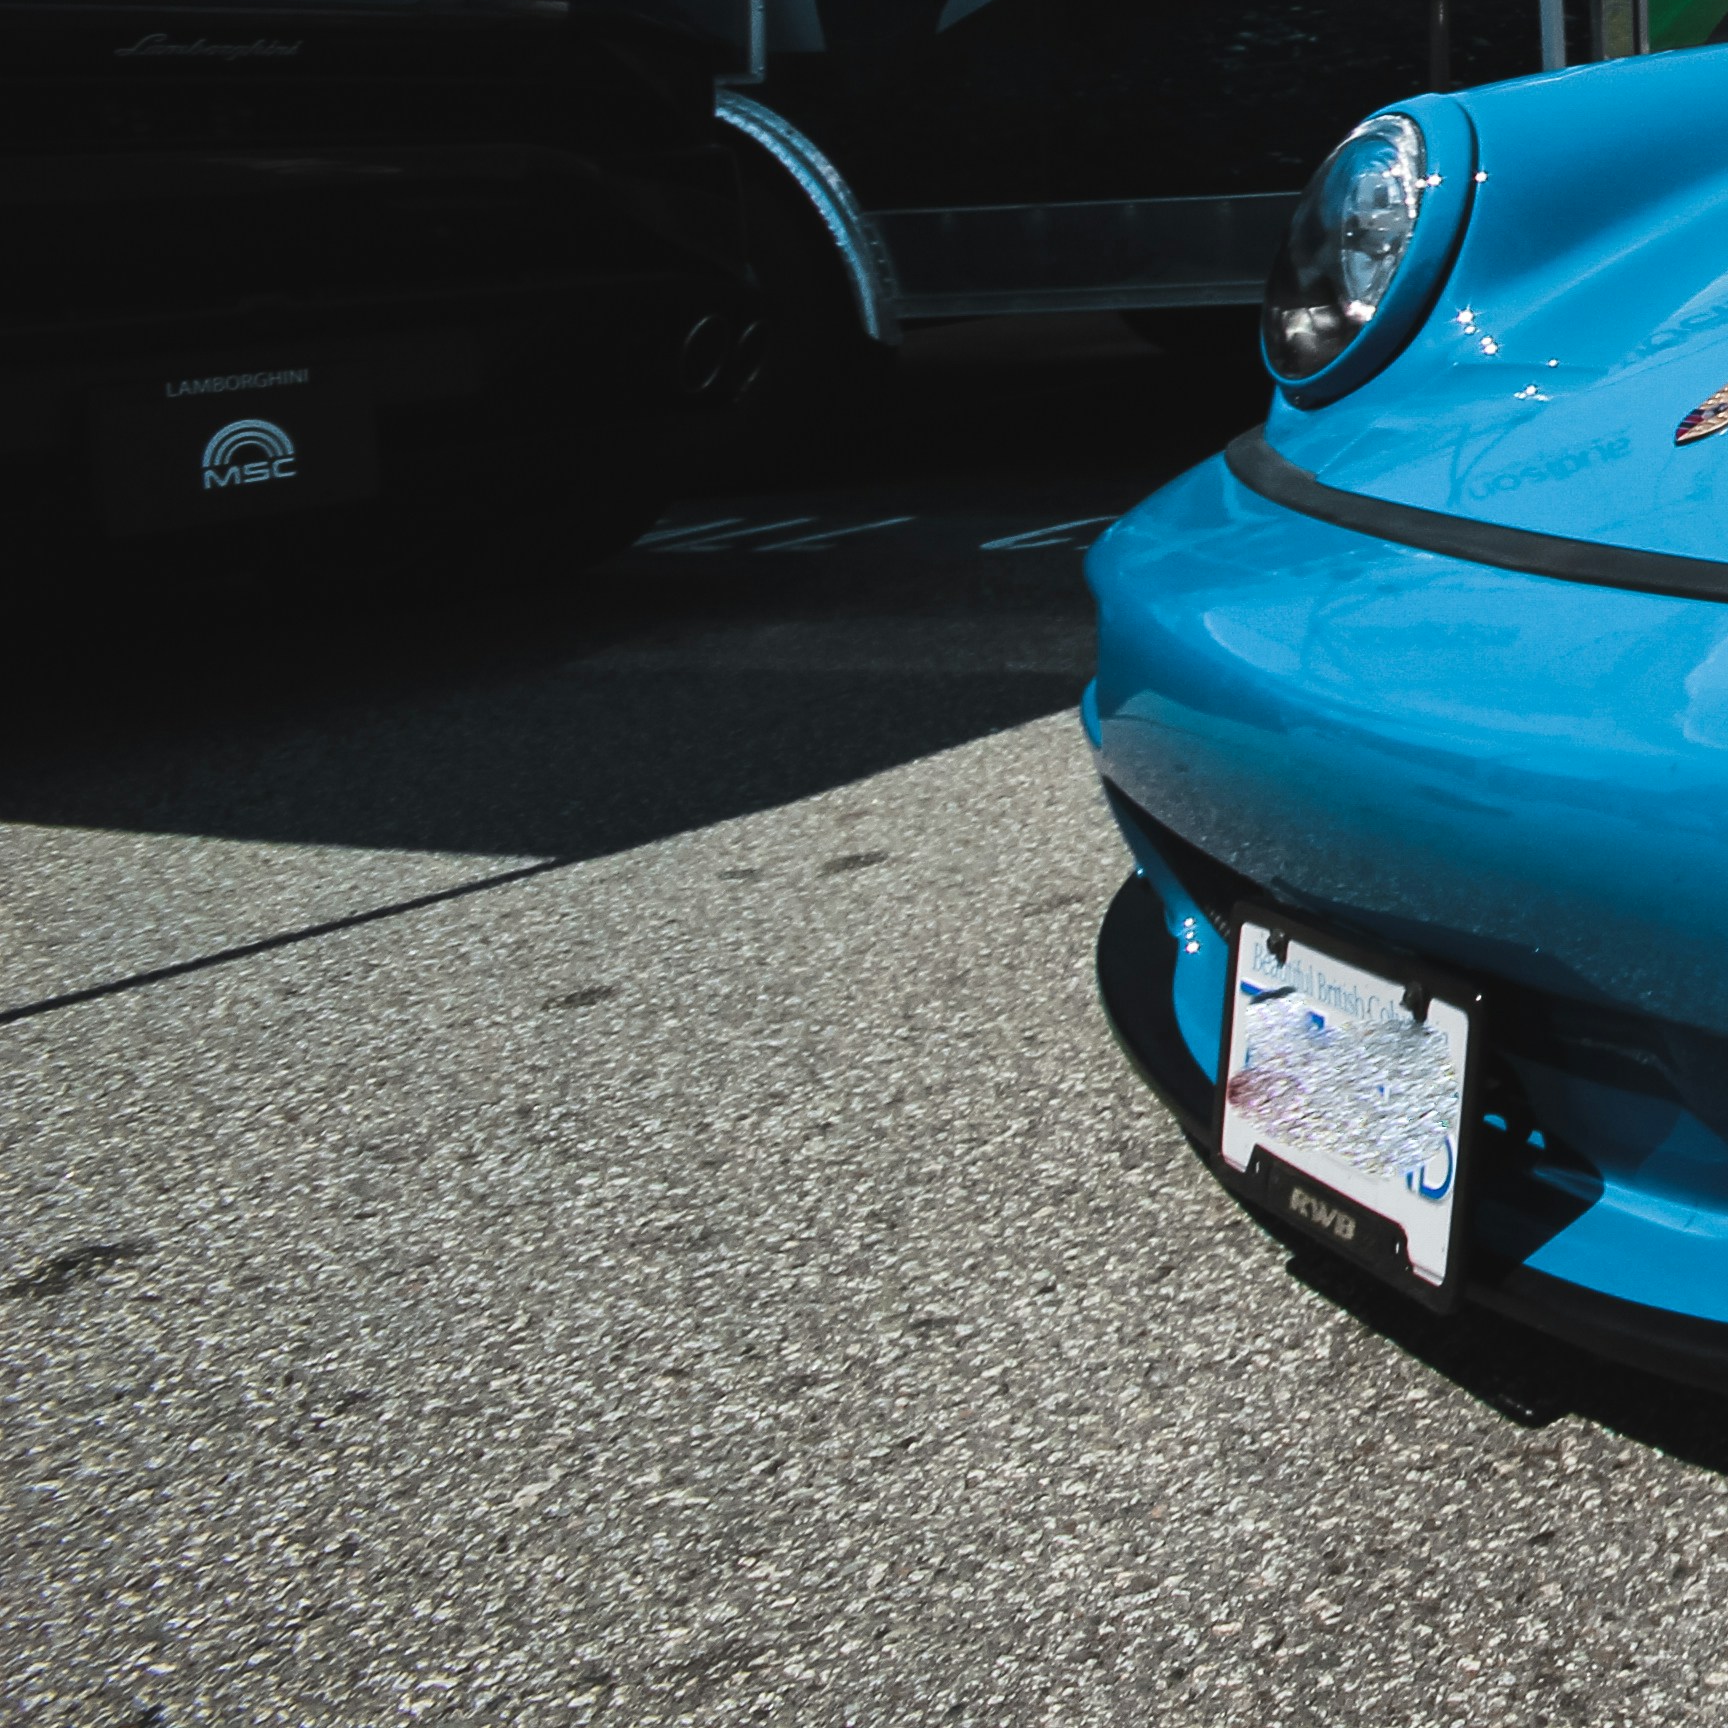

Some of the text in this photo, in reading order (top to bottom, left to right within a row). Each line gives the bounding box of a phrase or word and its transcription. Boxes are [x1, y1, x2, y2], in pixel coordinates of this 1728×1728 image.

[166, 368, 309, 399] LAMBORGHINI
[202, 457, 298, 491] MSC
[1318, 971, 1366, 1021] British
[1290, 1187, 1356, 1240] RWB
